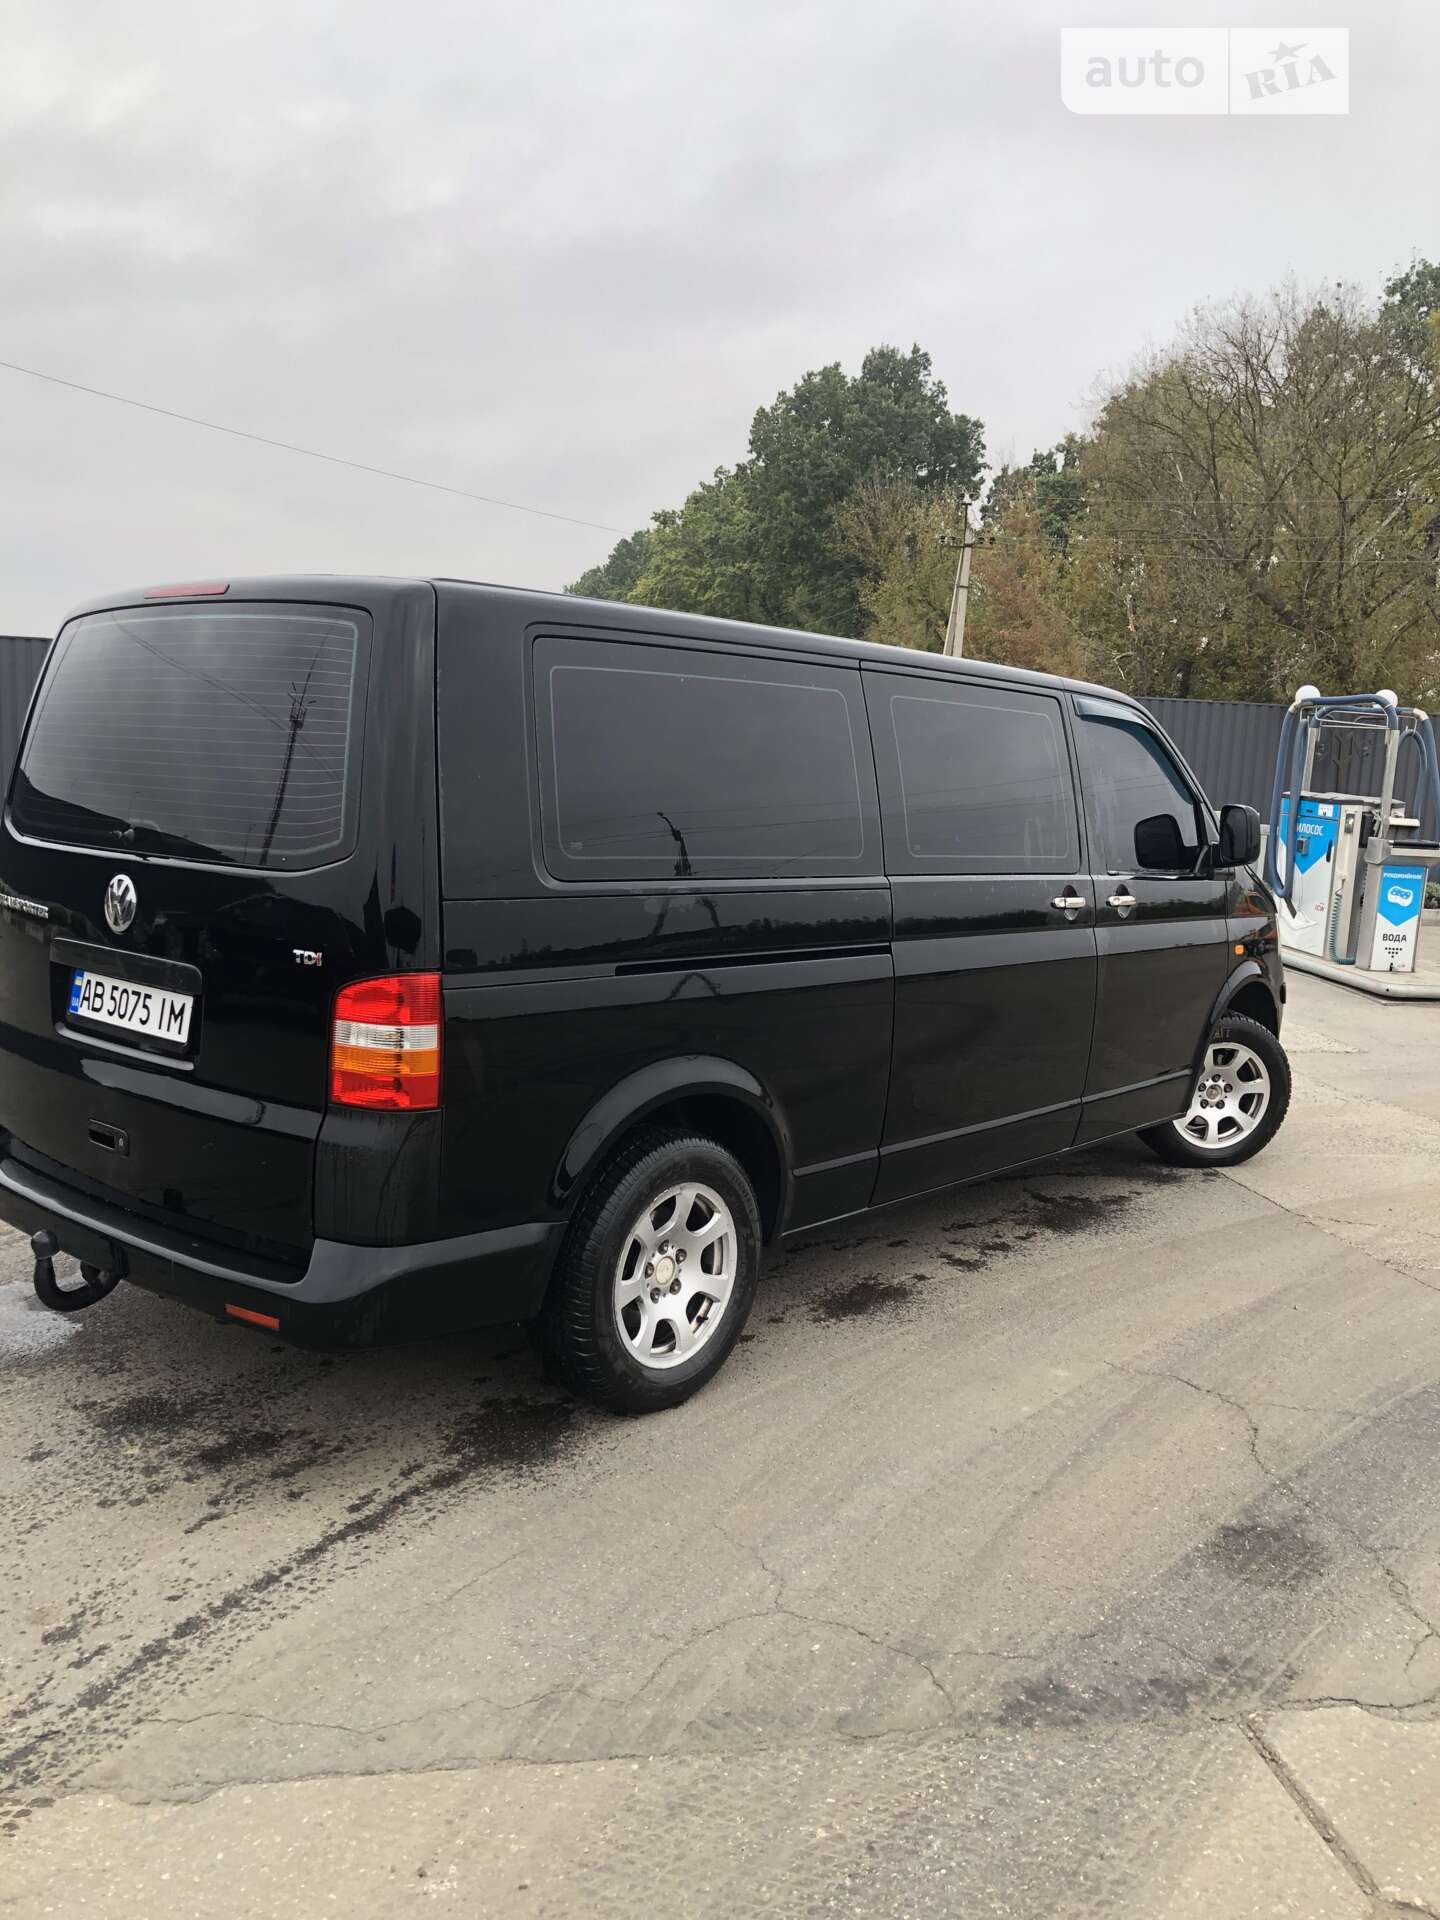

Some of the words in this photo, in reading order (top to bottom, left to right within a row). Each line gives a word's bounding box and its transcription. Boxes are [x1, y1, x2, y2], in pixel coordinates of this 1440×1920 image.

[1297, 823, 1324, 836] ИЛОСОС
[1382, 933, 1407, 943] ВОДА
[293, 949, 322, 966] TDI
[80, 979, 105, 1013] AB
[107, 985, 152, 1025] 5075
[158, 998, 186, 1035] IM
